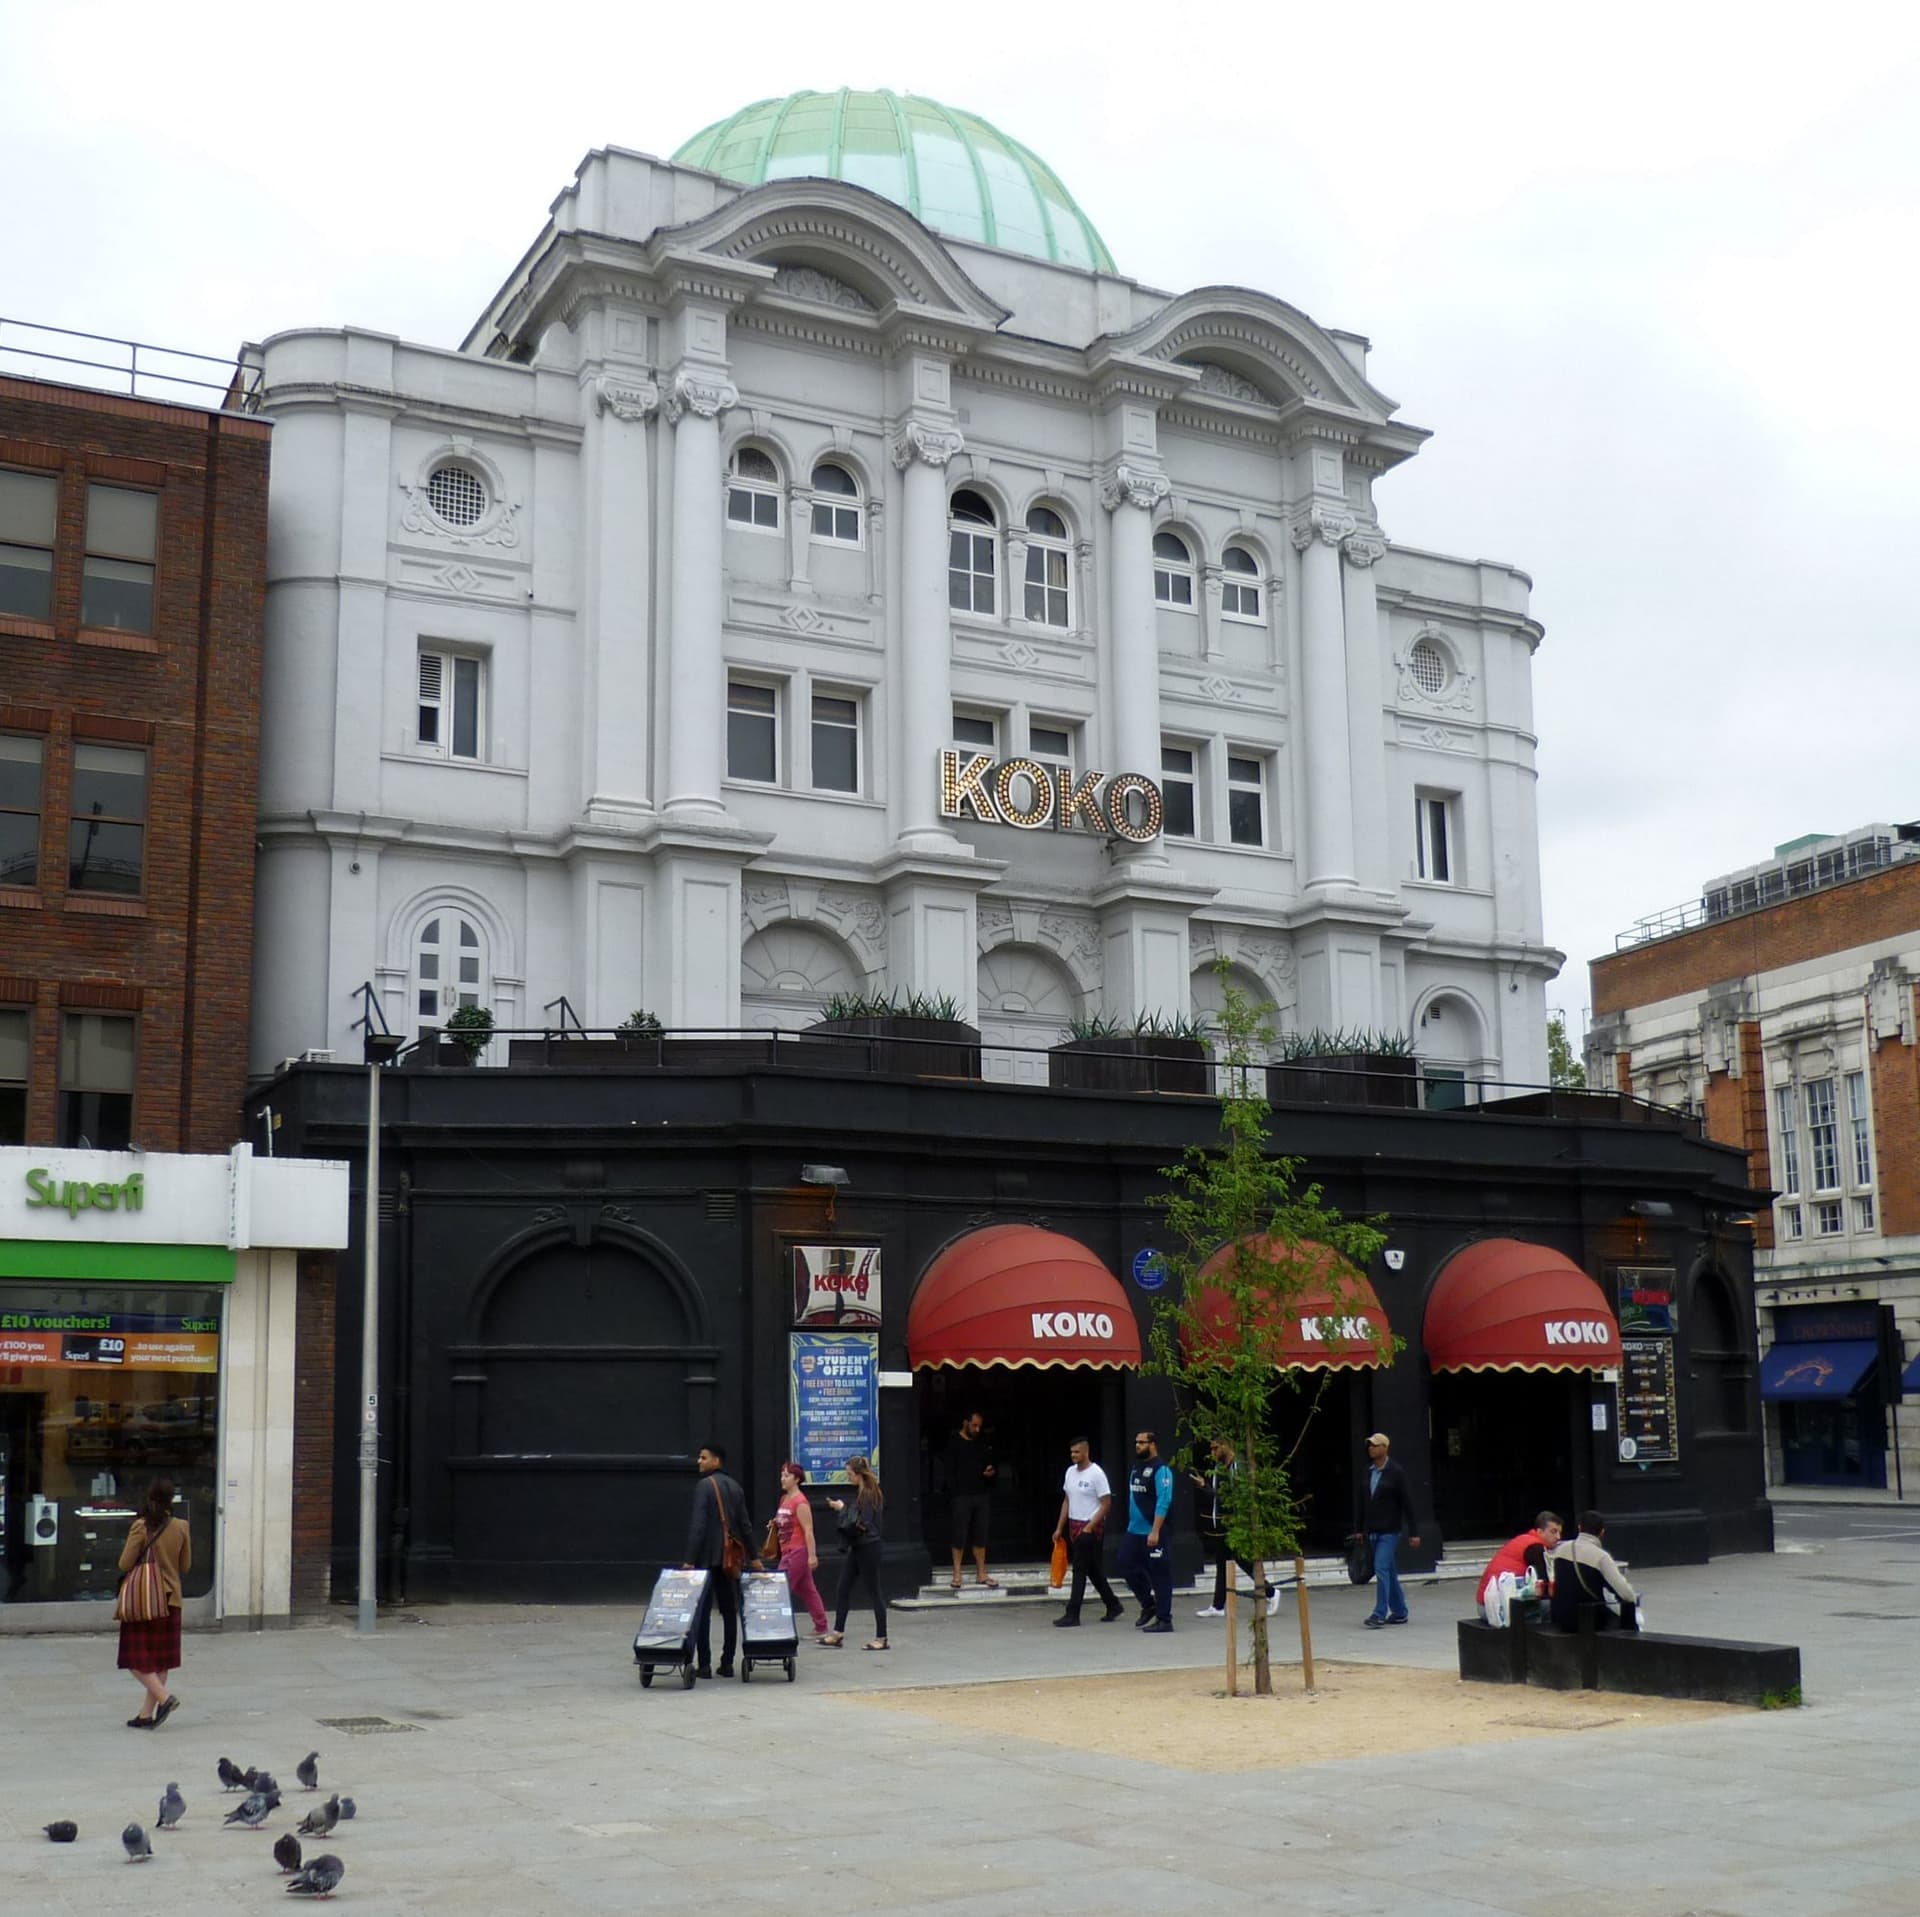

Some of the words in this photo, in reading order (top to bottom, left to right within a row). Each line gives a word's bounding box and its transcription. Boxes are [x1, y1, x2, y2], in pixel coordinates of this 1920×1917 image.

[938, 748, 1164, 843] KOKO
[26, 1168, 144, 1220] Superfi
[1, 1315, 30, 1328] £10
[33, 1315, 110, 1329] vouchers!
[181, 1317, 216, 1333] Superfi
[1032, 1312, 1113, 1338] KOKO
[1544, 1321, 1609, 1345] KOKO
[27, 1343, 45, 1352] you
[99, 1338, 124, 1352] £10
[816, 1355, 869, 1365] STUDENT
[823, 1365, 863, 1376] OFFER
[368, 1395, 376, 1405] 5
